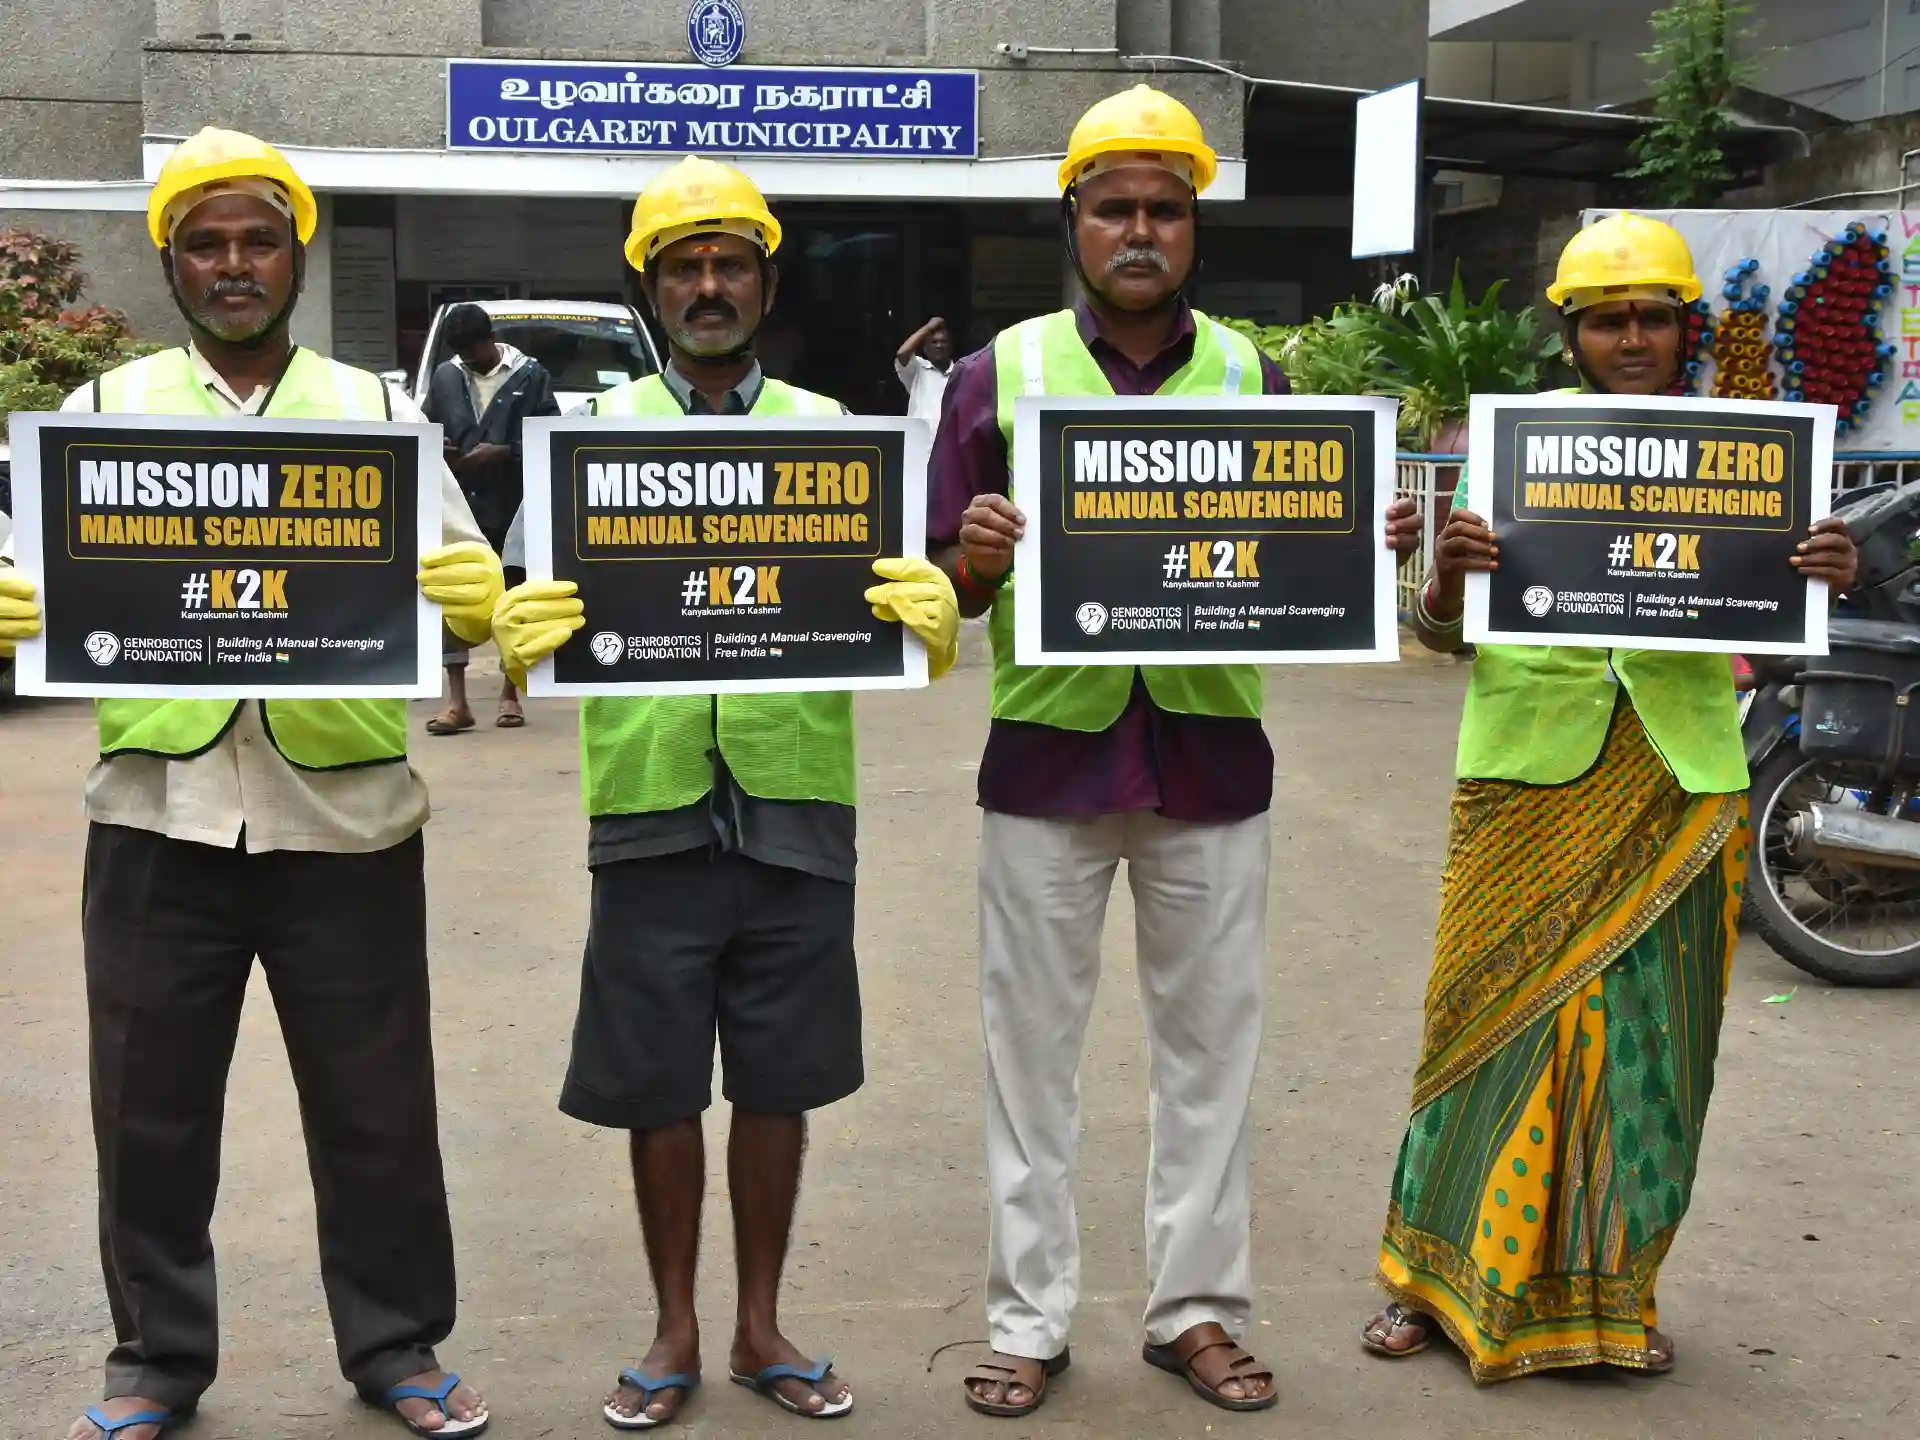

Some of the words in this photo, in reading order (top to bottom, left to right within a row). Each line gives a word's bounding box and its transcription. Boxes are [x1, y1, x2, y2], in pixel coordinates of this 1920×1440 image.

[500, 71, 745, 110] உழவர்கரை
[753, 79, 933, 112] நகராட்சி
[468, 115, 677, 145] OULGARET
[686, 121, 962, 151] MUNICIPALITY
[1074, 440, 1243, 483] MISSION
[1252, 440, 1344, 482] ZERO
[1526, 436, 1688, 479] MISSION
[1696, 441, 1784, 484] ZERO
[80, 460, 269, 508] MISSION
[280, 465, 382, 509] ZERO
[587, 462, 764, 507] MISSION
[774, 461, 870, 505] ZERO
[1074, 492, 1178, 519] MANUAL
[1184, 490, 1343, 519] SCAVENGING
[1524, 482, 1625, 511] MANUAL
[1630, 485, 1782, 517] SCAVENGING
[80, 515, 197, 545] MANUAL
[204, 516, 380, 547] SCAVENGING
[587, 515, 697, 545] MANUAL
[703, 513, 868, 543] SCAVENGING
[1607, 533, 1700, 570] #K2K
[1163, 540, 1260, 579] #K2K
[1607, 568, 1656, 579] Kanyakumari
[1658, 570, 1666, 578] to
[1668, 571, 1700, 580] Kashmir
[181, 569, 289, 609] #K2K
[681, 566, 782, 606] #K2K
[1163, 580, 1215, 590] Kanyakumari
[1216, 581, 1225, 589] to
[1227, 580, 1260, 589] Kashmir
[1557, 591, 1625, 604] GENROBOTICS
[1636, 594, 1677, 607] Building
[1678, 596, 1686, 605] A
[1688, 596, 1724, 607] Manual
[1726, 598, 1779, 611] Scavenging
[681, 607, 735, 617] Kanyakumari
[748, 606, 782, 615] Kashmir
[1111, 607, 1182, 618] GENROBOTICS
[1194, 605, 1236, 618] Building
[1238, 606, 1247, 616] A
[1249, 605, 1287, 616] Manual
[1288, 605, 1346, 618] Scavenging
[1557, 602, 1624, 615] FOUNDATION
[1635, 607, 1658, 618] Free
[1660, 608, 1684, 619] India
[181, 611, 239, 621] Kanyakumari
[252, 611, 289, 619] Kashmir
[1111, 618, 1182, 630] FOUNDATION
[1194, 620, 1218, 630] Free
[1220, 619, 1245, 630] India
[124, 638, 203, 649] GENROBOTICS
[217, 637, 262, 649] Building
[265, 638, 274, 647] A
[277, 638, 318, 648] Manual
[321, 638, 385, 650] Scavenging
[628, 635, 701, 647] GENROBOTICS
[714, 633, 758, 645] Building
[760, 633, 768, 643] A
[771, 632, 809, 642] Manual
[812, 631, 872, 643] Scavenging
[124, 650, 202, 662] FOUNDATION
[217, 652, 241, 663] Free
[245, 652, 272, 663] India
[628, 647, 701, 659] FOUNDATION
[714, 648, 738, 659] Free
[741, 647, 767, 658] India
